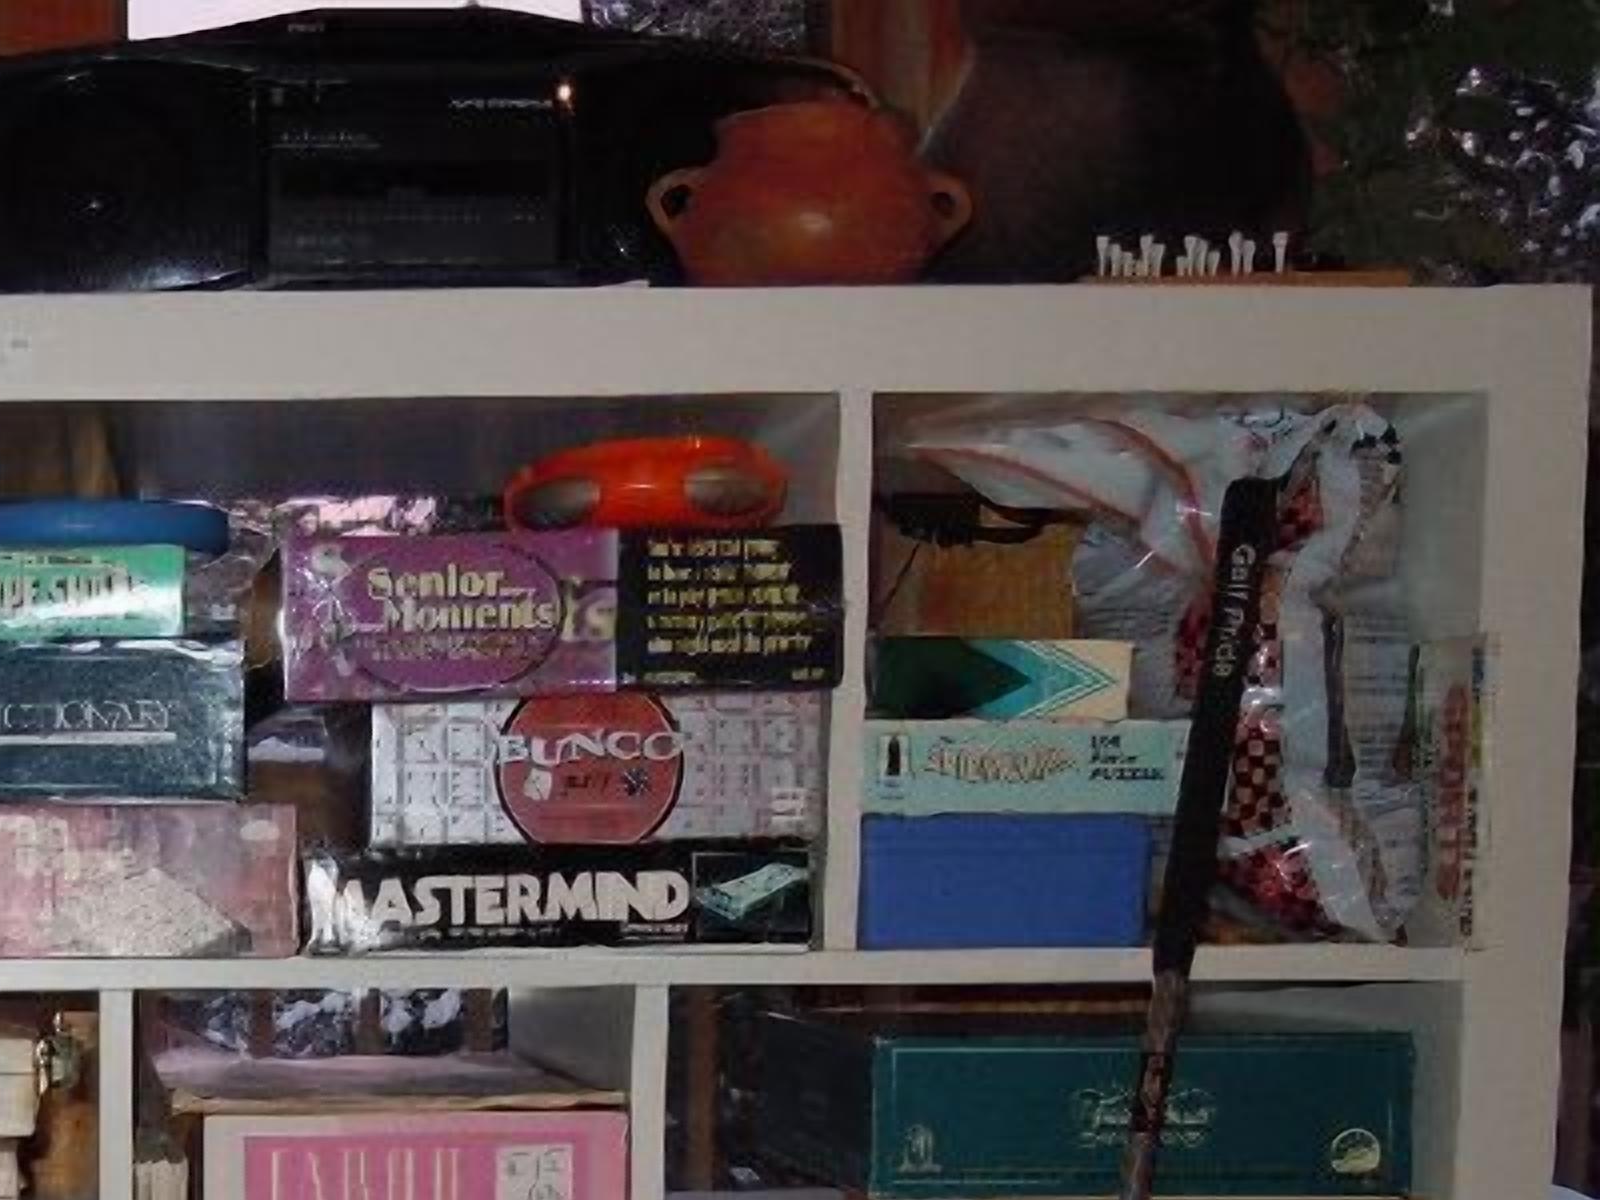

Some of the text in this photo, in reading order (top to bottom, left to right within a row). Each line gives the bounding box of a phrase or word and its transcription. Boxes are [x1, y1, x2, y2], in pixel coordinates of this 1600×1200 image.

[367, 562, 505, 601] Senior
[498, 728, 687, 766] BUNCO
[342, 869, 692, 928] MASTERMIND
